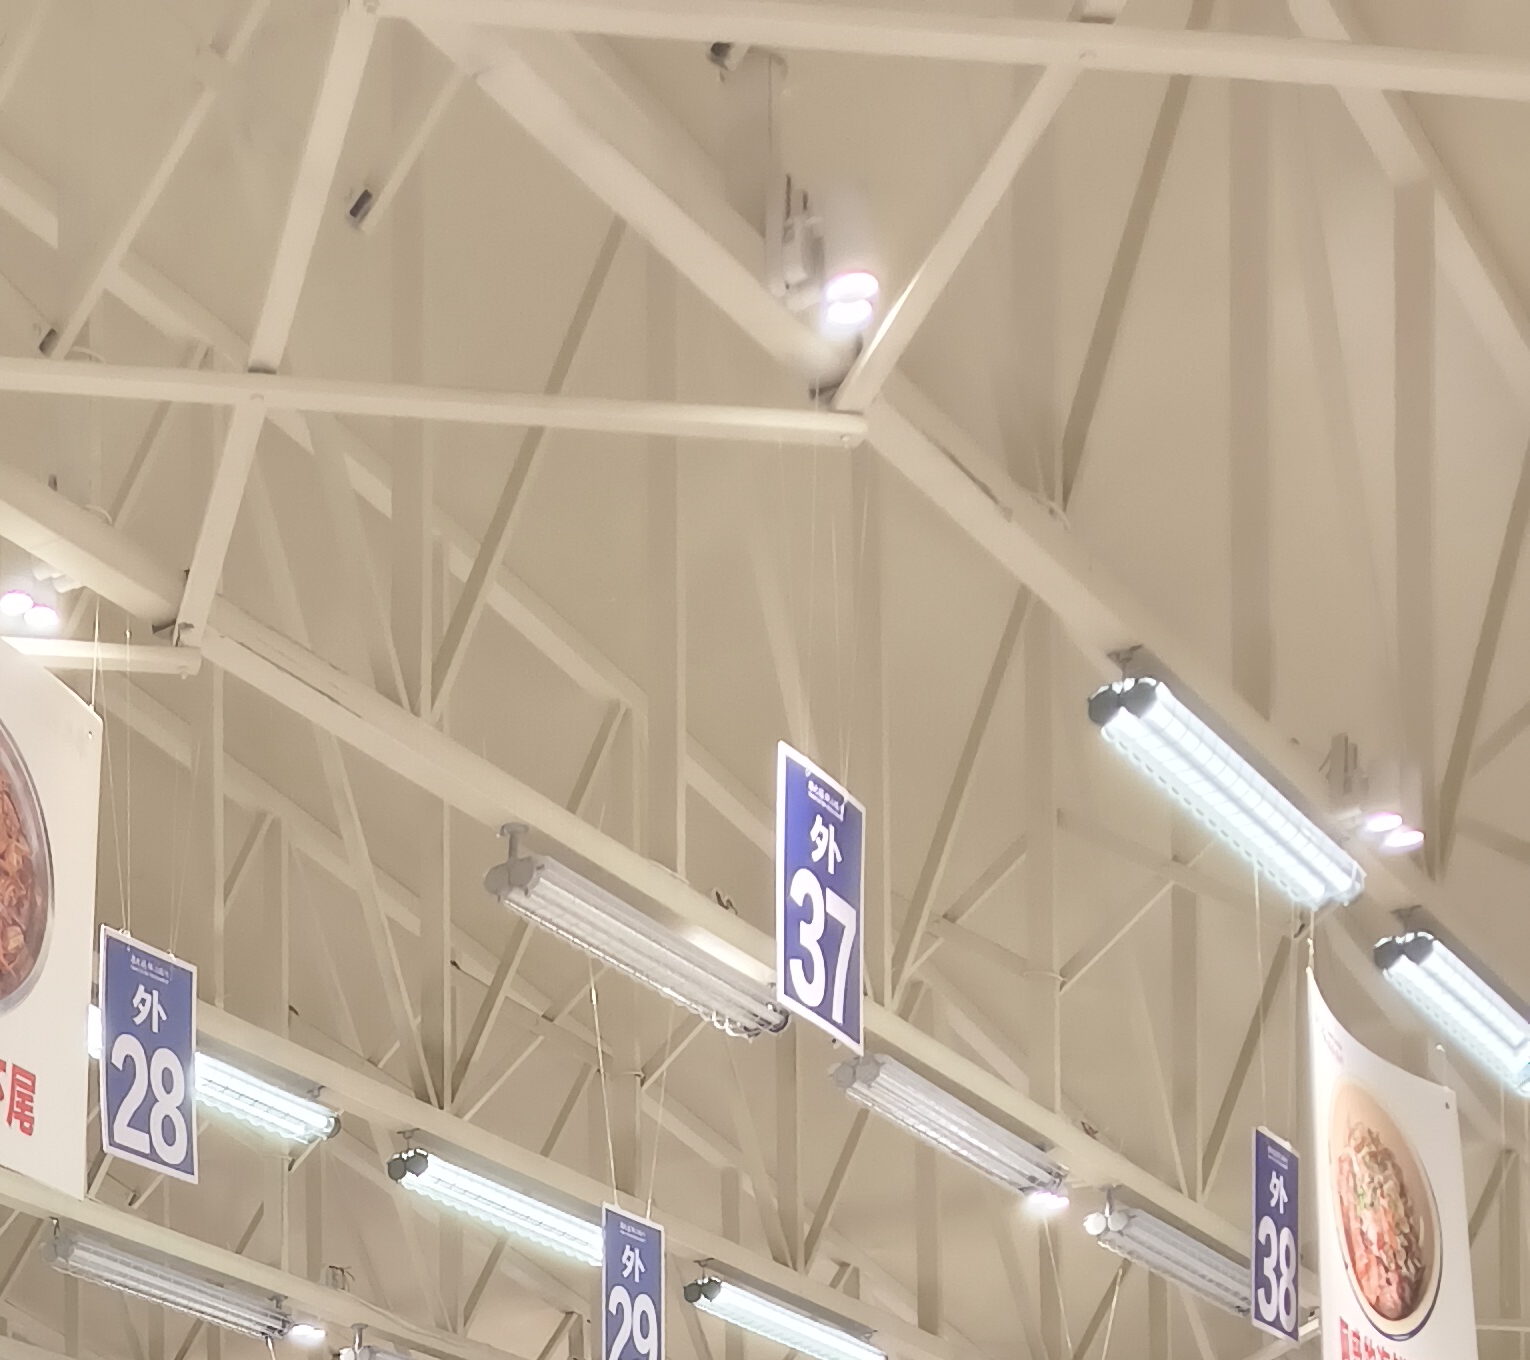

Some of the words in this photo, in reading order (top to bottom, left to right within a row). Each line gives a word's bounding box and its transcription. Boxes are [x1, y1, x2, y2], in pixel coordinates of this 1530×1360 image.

[810, 814, 842, 874] 外
[789, 868, 857, 1025] 37
[132, 984, 167, 1033] 外
[111, 1034, 188, 1164] 28
[1270, 1169, 1289, 1215] 外
[622, 1244, 646, 1283] 外
[1257, 1216, 1298, 1333] 38
